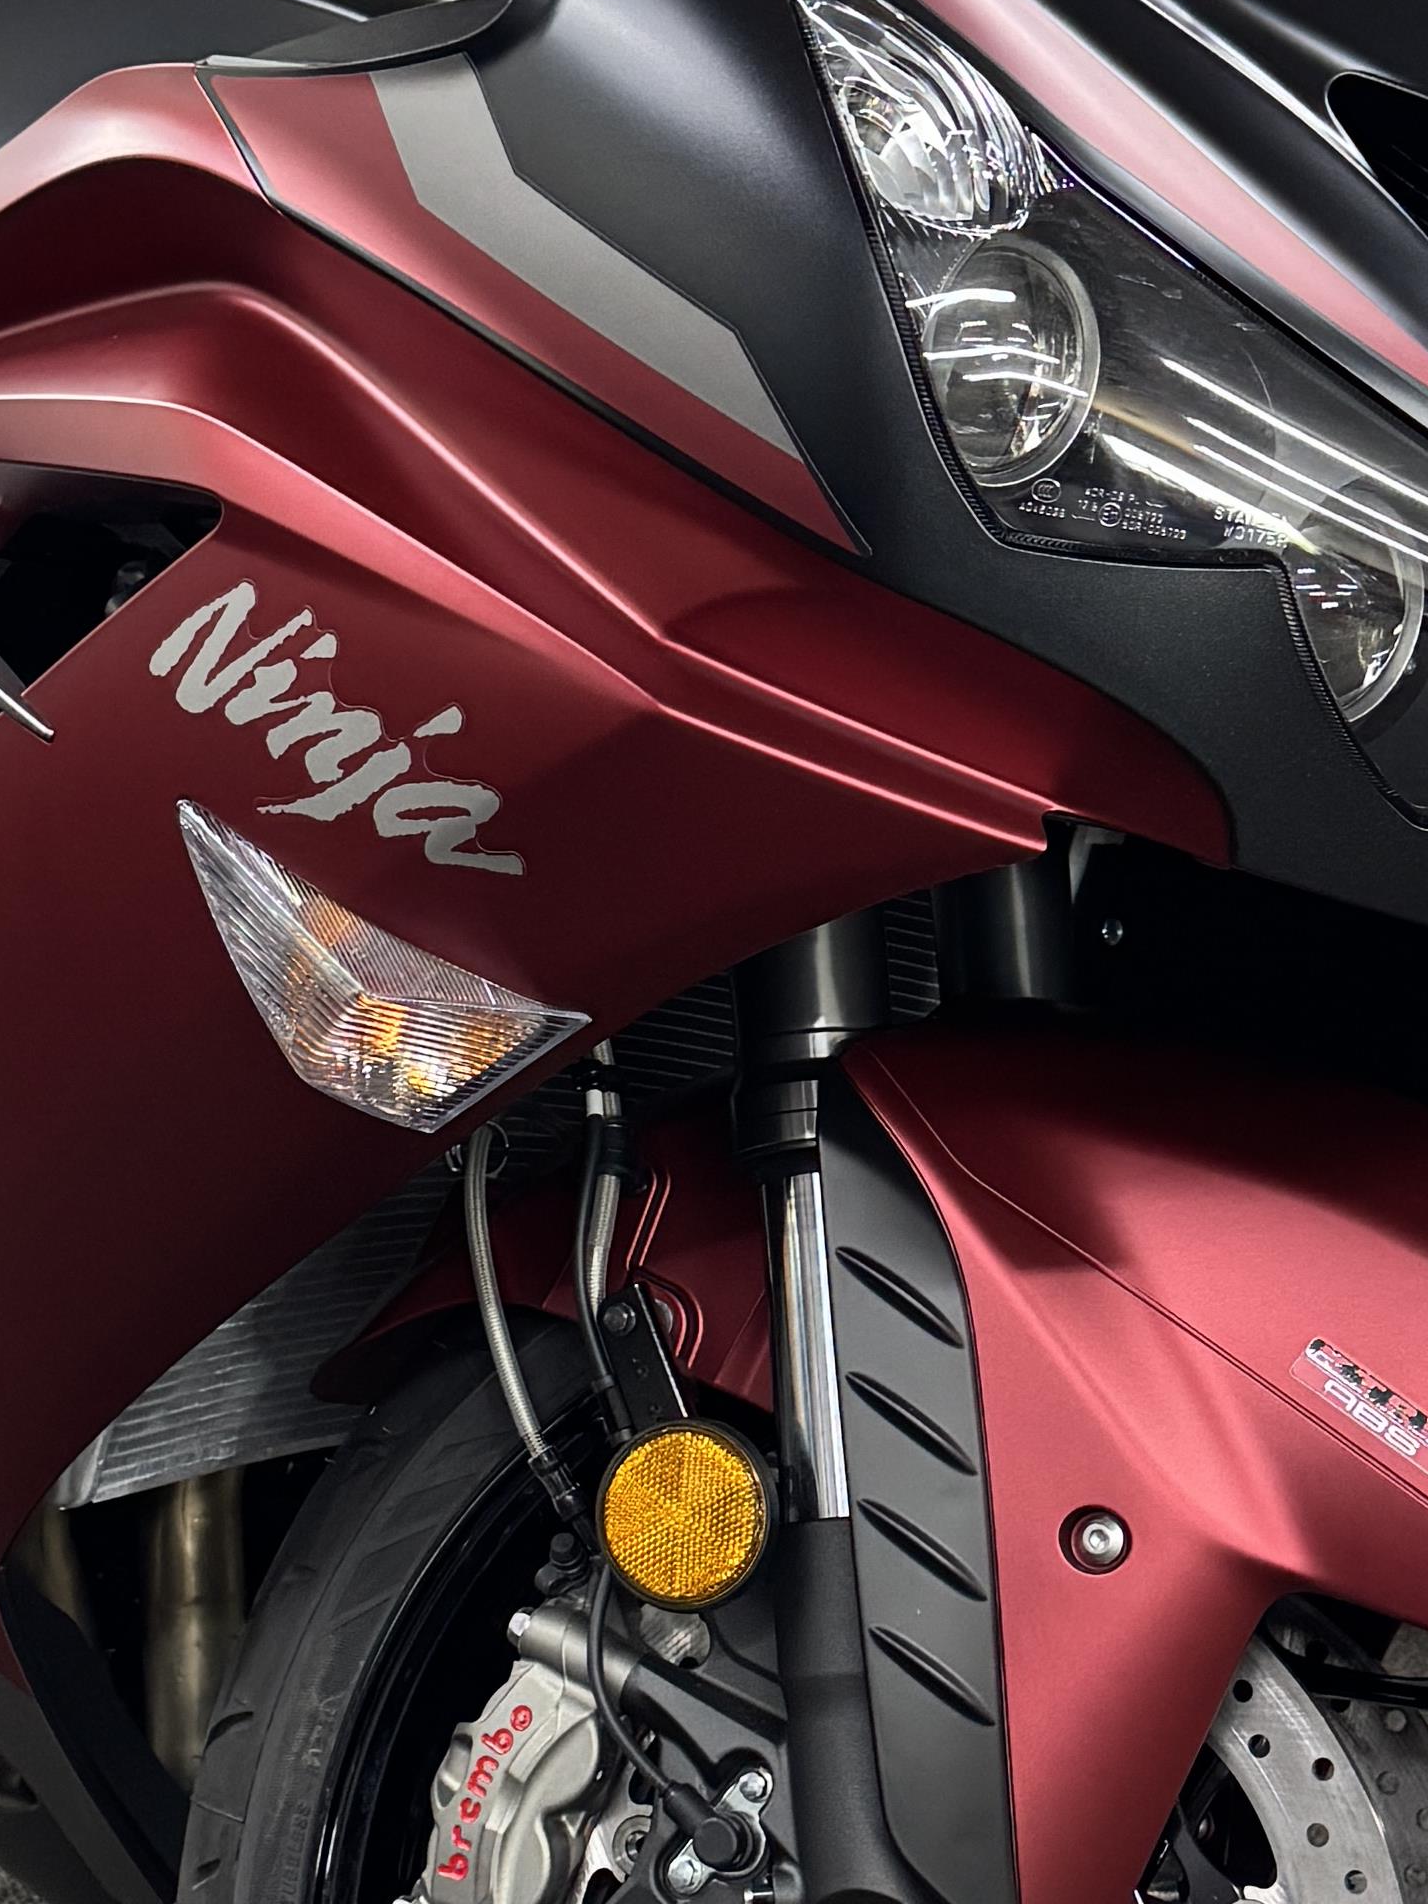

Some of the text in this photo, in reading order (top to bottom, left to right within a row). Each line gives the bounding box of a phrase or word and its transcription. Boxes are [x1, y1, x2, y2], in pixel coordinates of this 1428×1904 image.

[148, 581, 525, 876] Ninja
[1322, 1378, 1421, 1457] ABS
[437, 1704, 534, 1882] brembo
